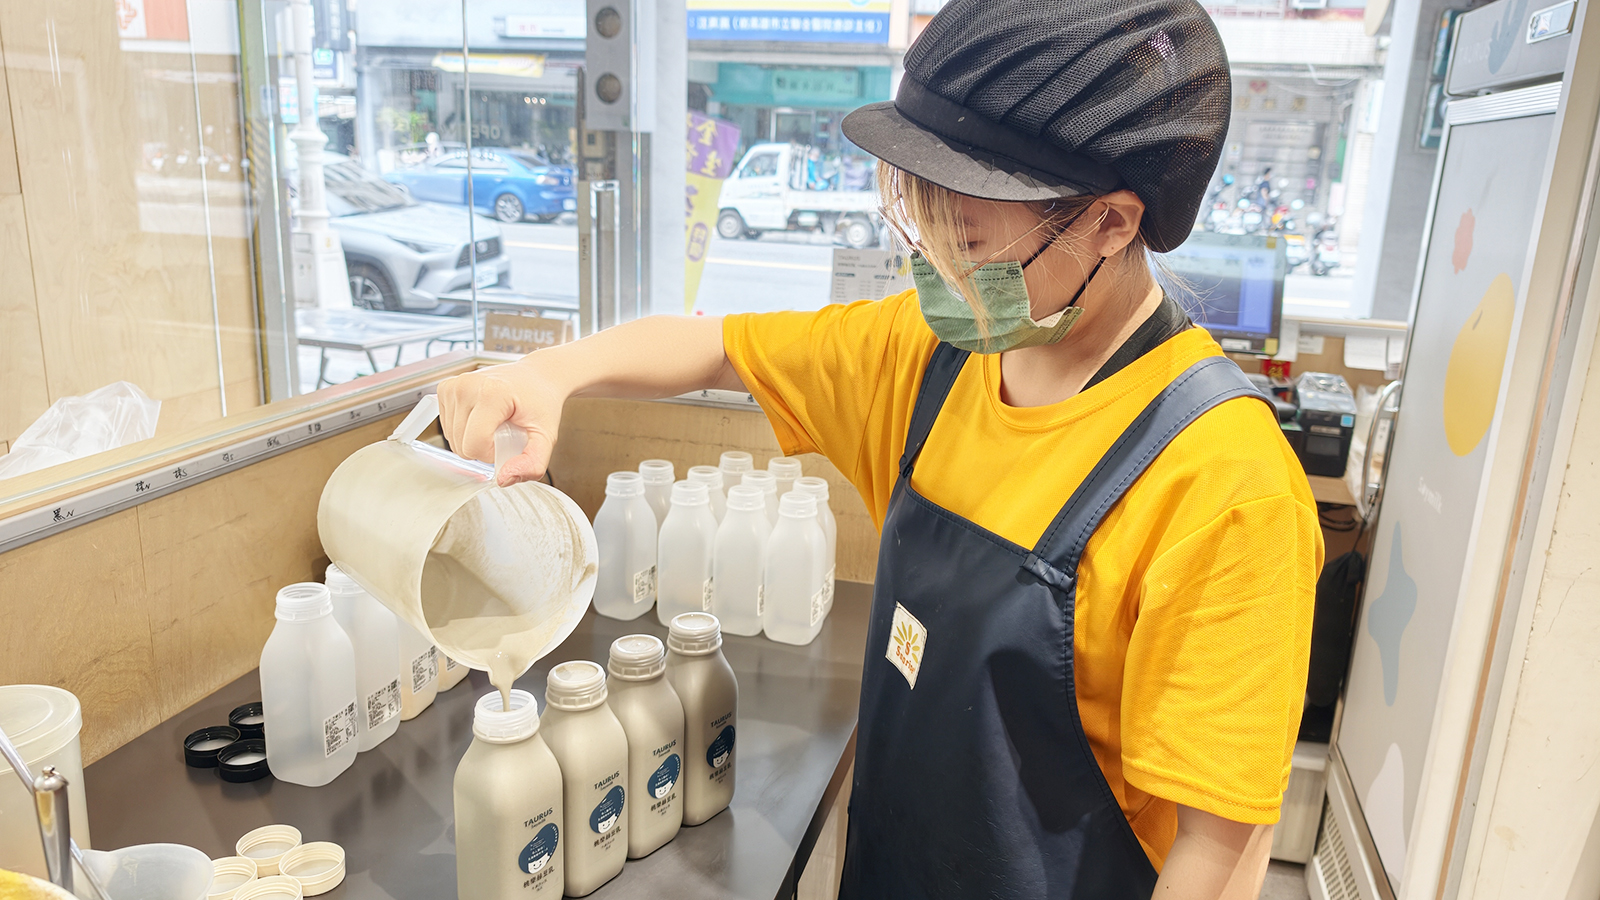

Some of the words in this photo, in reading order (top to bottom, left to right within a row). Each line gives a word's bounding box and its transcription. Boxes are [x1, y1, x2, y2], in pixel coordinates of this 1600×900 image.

[491, 324, 555, 345] TAURUS
[711, 711, 732, 728] TAURUS
[653, 739, 676, 756] TAURUS
[594, 771, 620, 790] TAURUS
[524, 807, 553, 828] TAURUS
